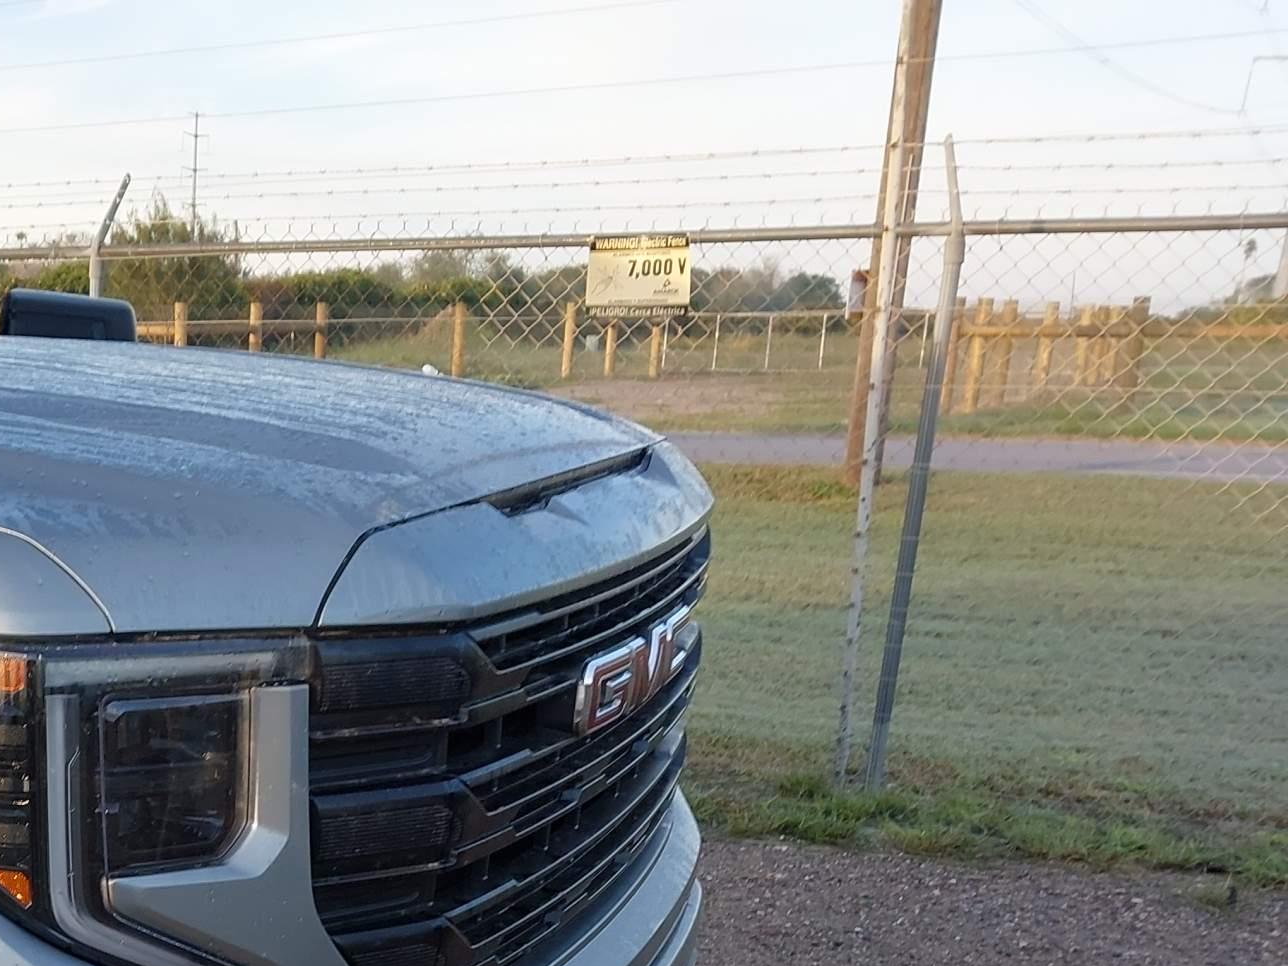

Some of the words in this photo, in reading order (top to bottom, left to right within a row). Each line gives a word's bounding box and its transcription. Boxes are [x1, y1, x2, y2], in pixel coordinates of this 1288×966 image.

[627, 258, 674, 280] 7,000
[677, 257, 687, 275] V
[576, 604, 690, 736] GMC
